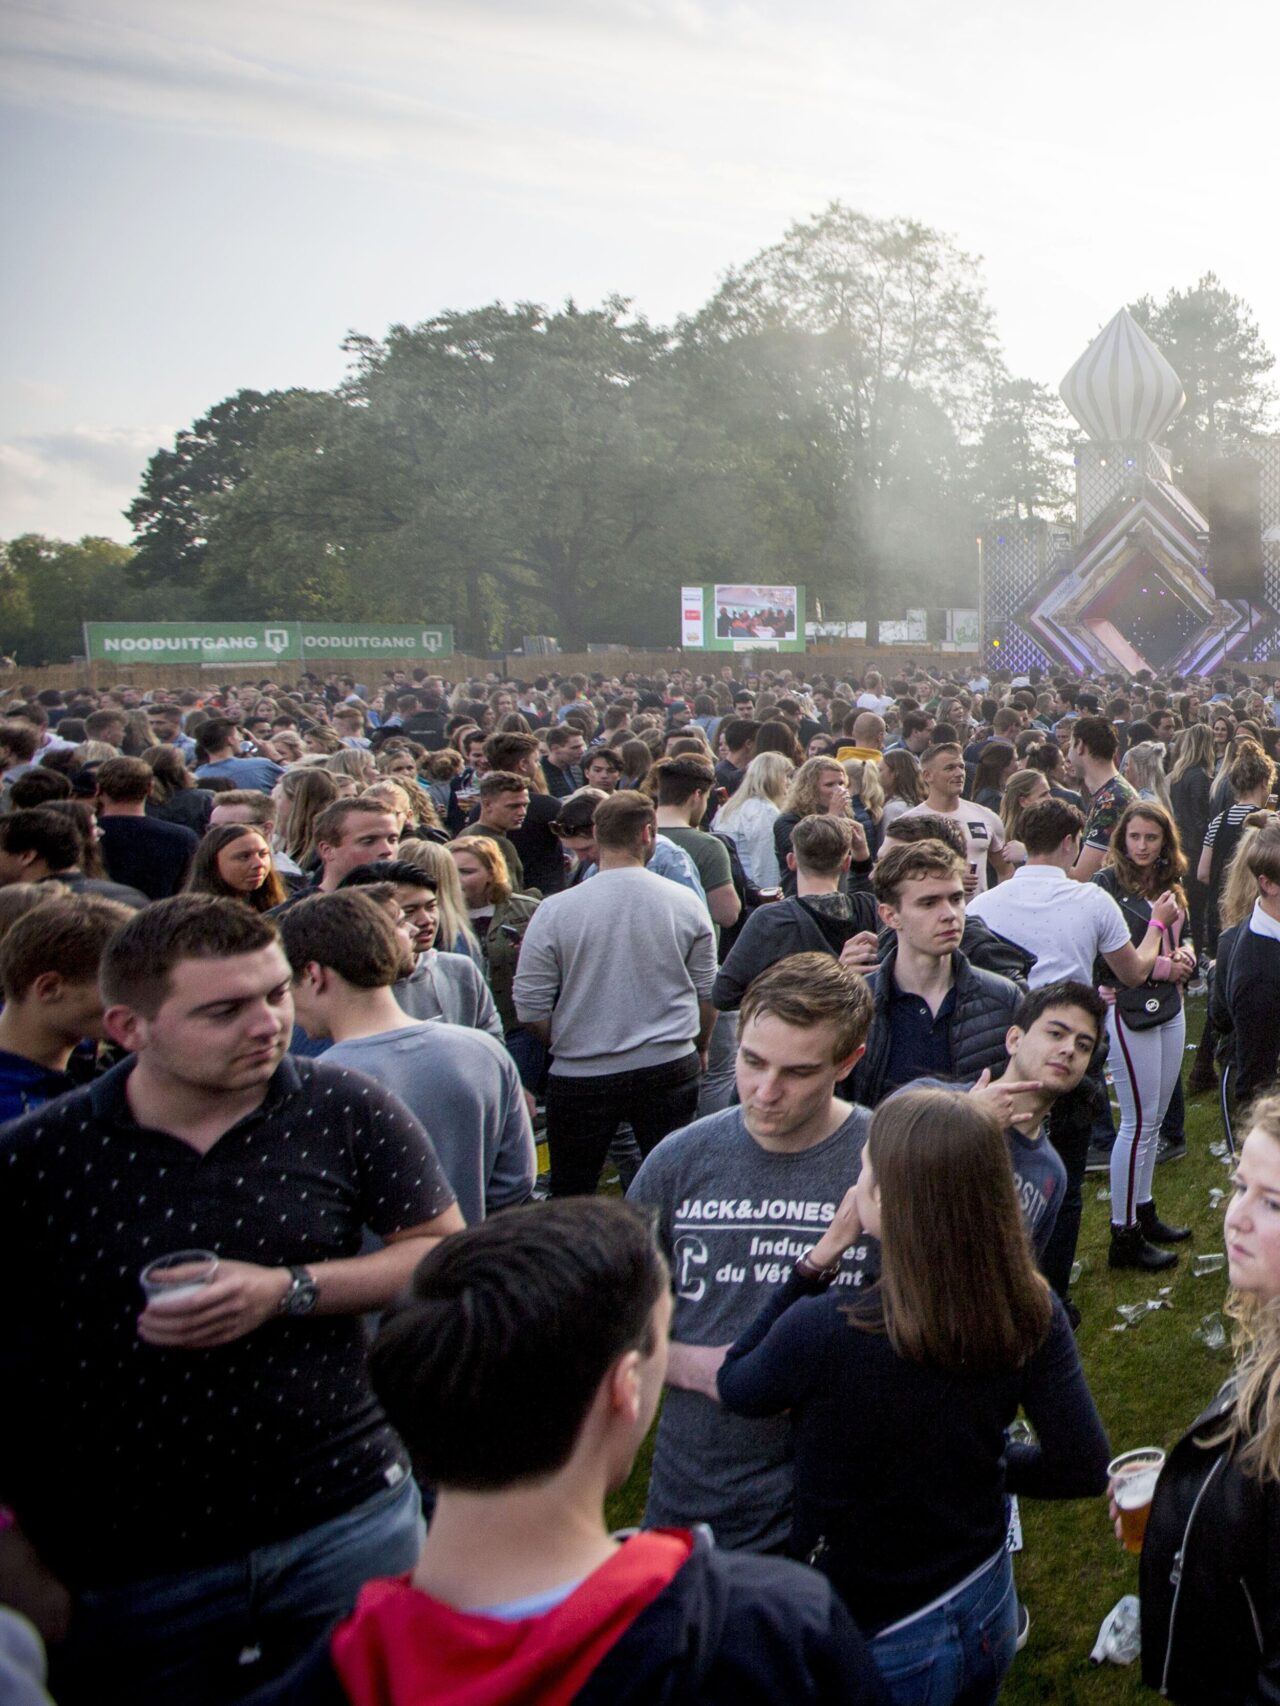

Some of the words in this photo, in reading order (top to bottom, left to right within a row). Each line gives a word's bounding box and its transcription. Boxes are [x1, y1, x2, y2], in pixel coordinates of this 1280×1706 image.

[104, 636, 258, 651] NOODUITGANG
[675, 1199, 837, 1222] JACK&JONES
[715, 1263, 746, 1283] du
